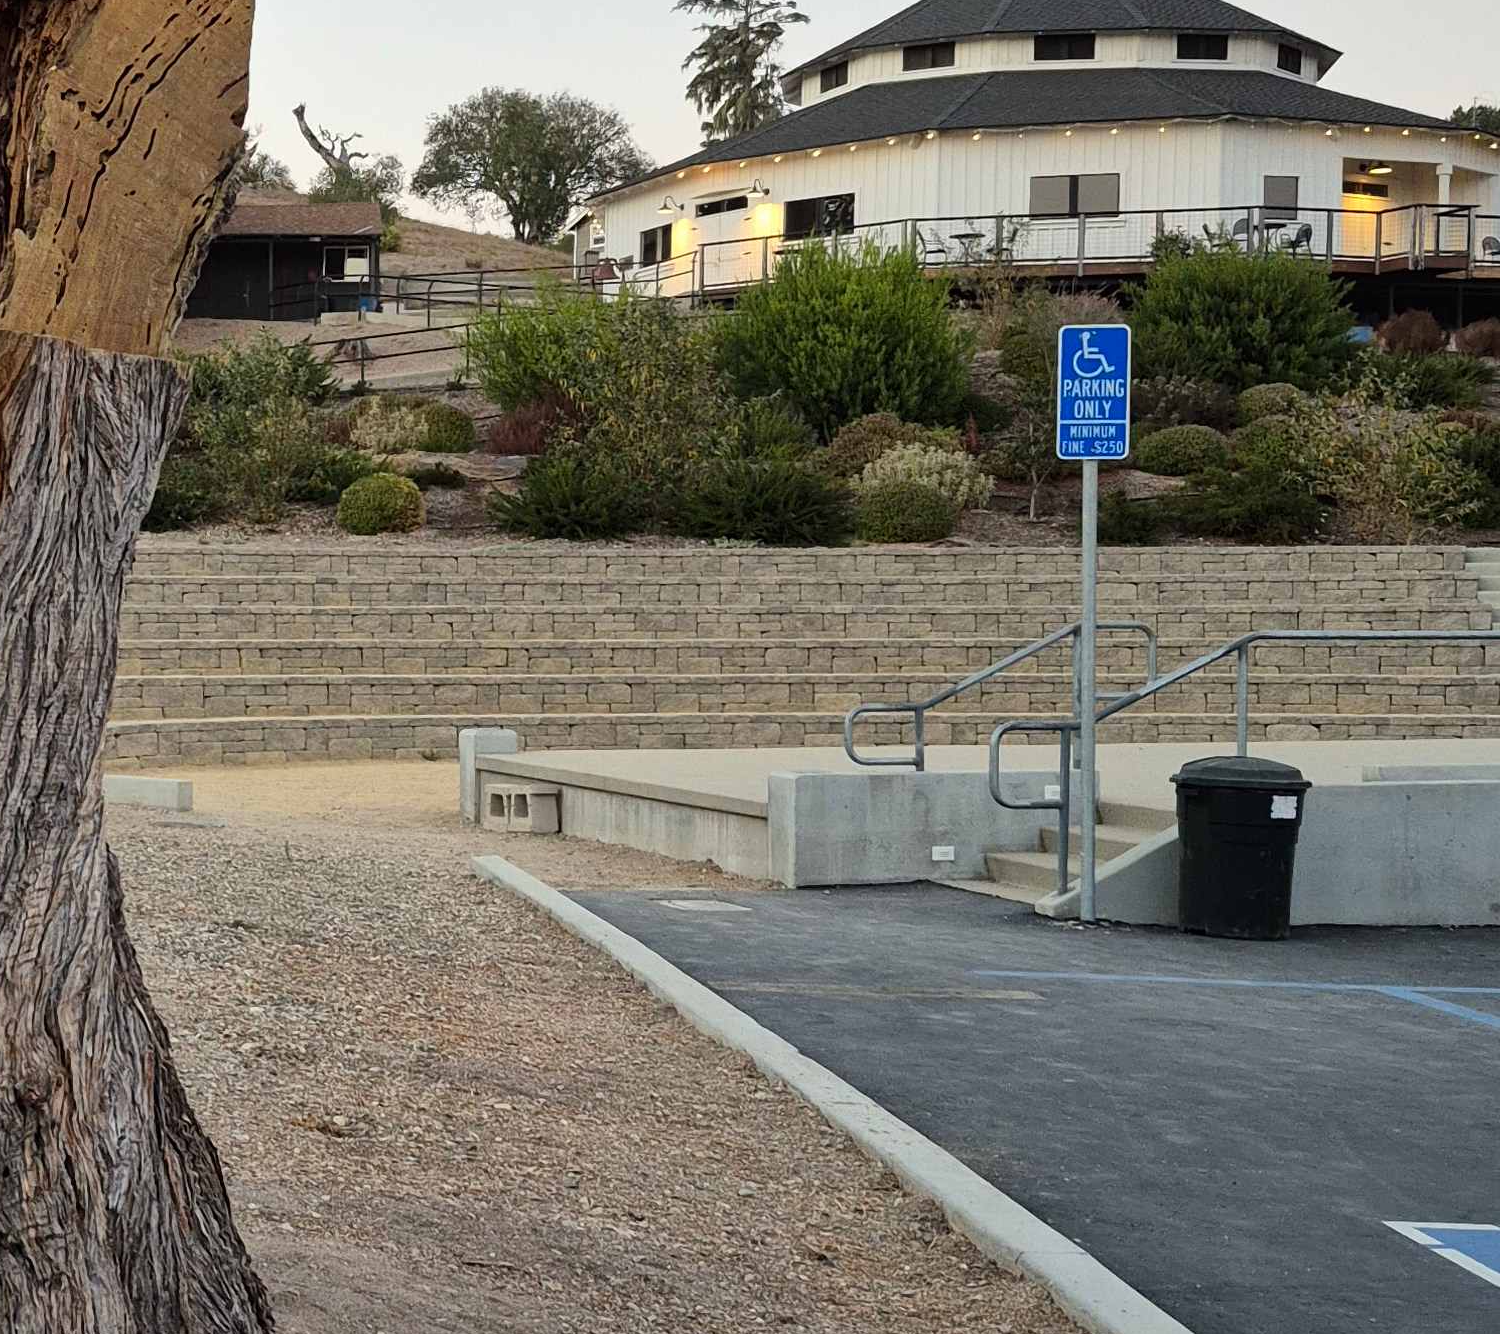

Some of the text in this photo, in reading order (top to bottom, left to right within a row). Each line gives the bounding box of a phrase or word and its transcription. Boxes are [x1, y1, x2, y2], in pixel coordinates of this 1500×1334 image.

[1063, 379, 1125, 398] PARKING
[1074, 400, 1112, 419] ONLY
[1070, 425, 1116, 438] MINIMUM
[1062, 441, 1124, 454] FINE $250
